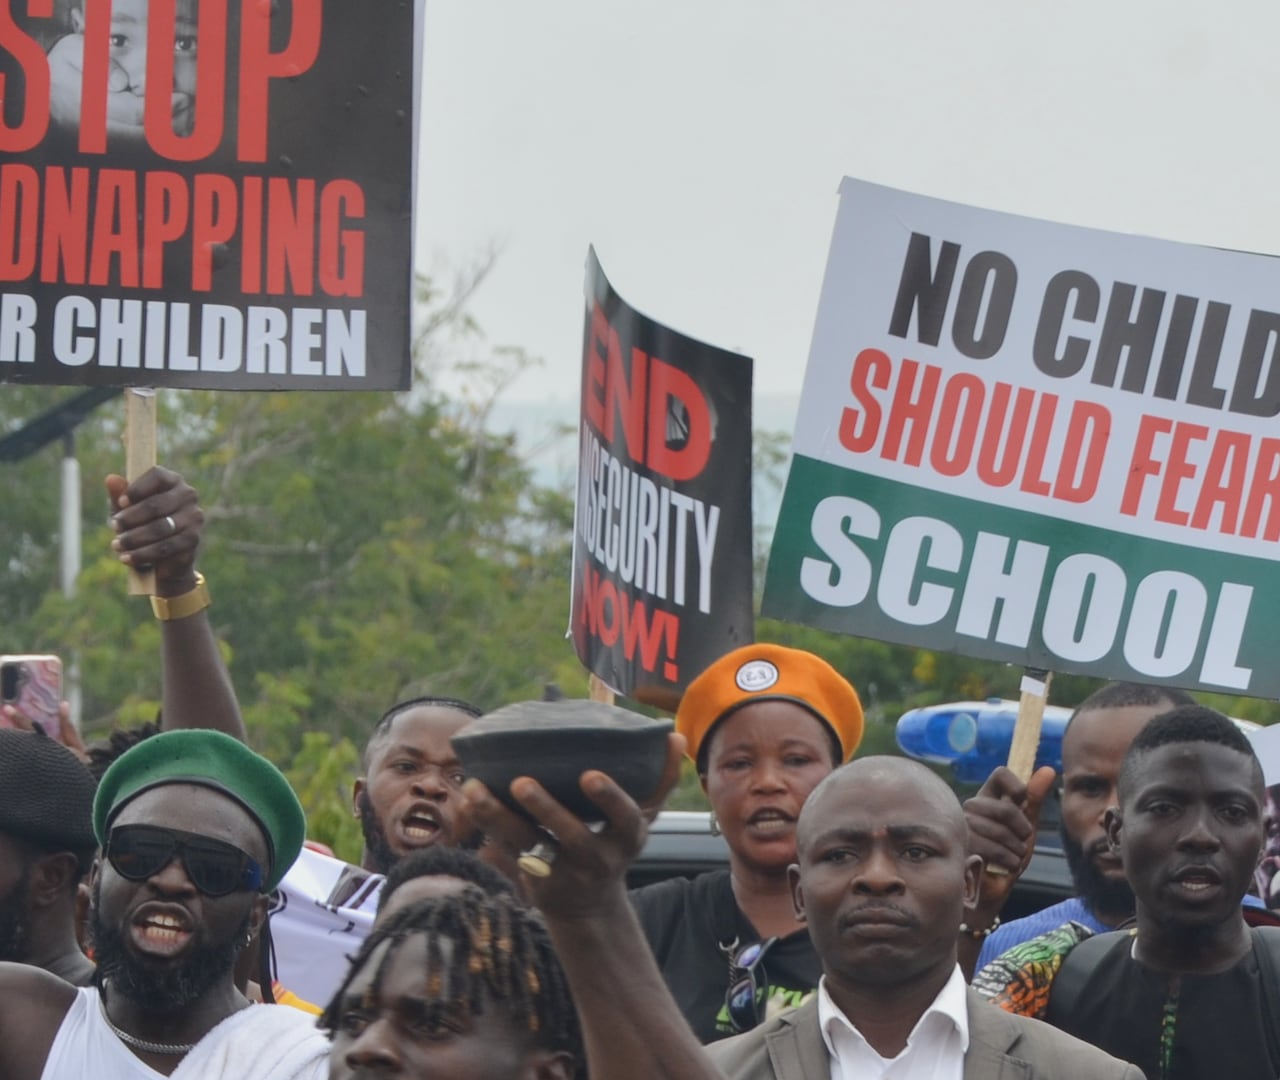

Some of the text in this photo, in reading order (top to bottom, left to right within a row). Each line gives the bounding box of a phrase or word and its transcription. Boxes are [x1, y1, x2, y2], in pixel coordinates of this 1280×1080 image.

[53, 296, 366, 376] CHILDREN
[888, 231, 1018, 360] NO
[584, 300, 713, 481] END
[837, 347, 1113, 504] SHOULD
[581, 559, 681, 683] NOW!
[799, 495, 1256, 690] SCHOOL
